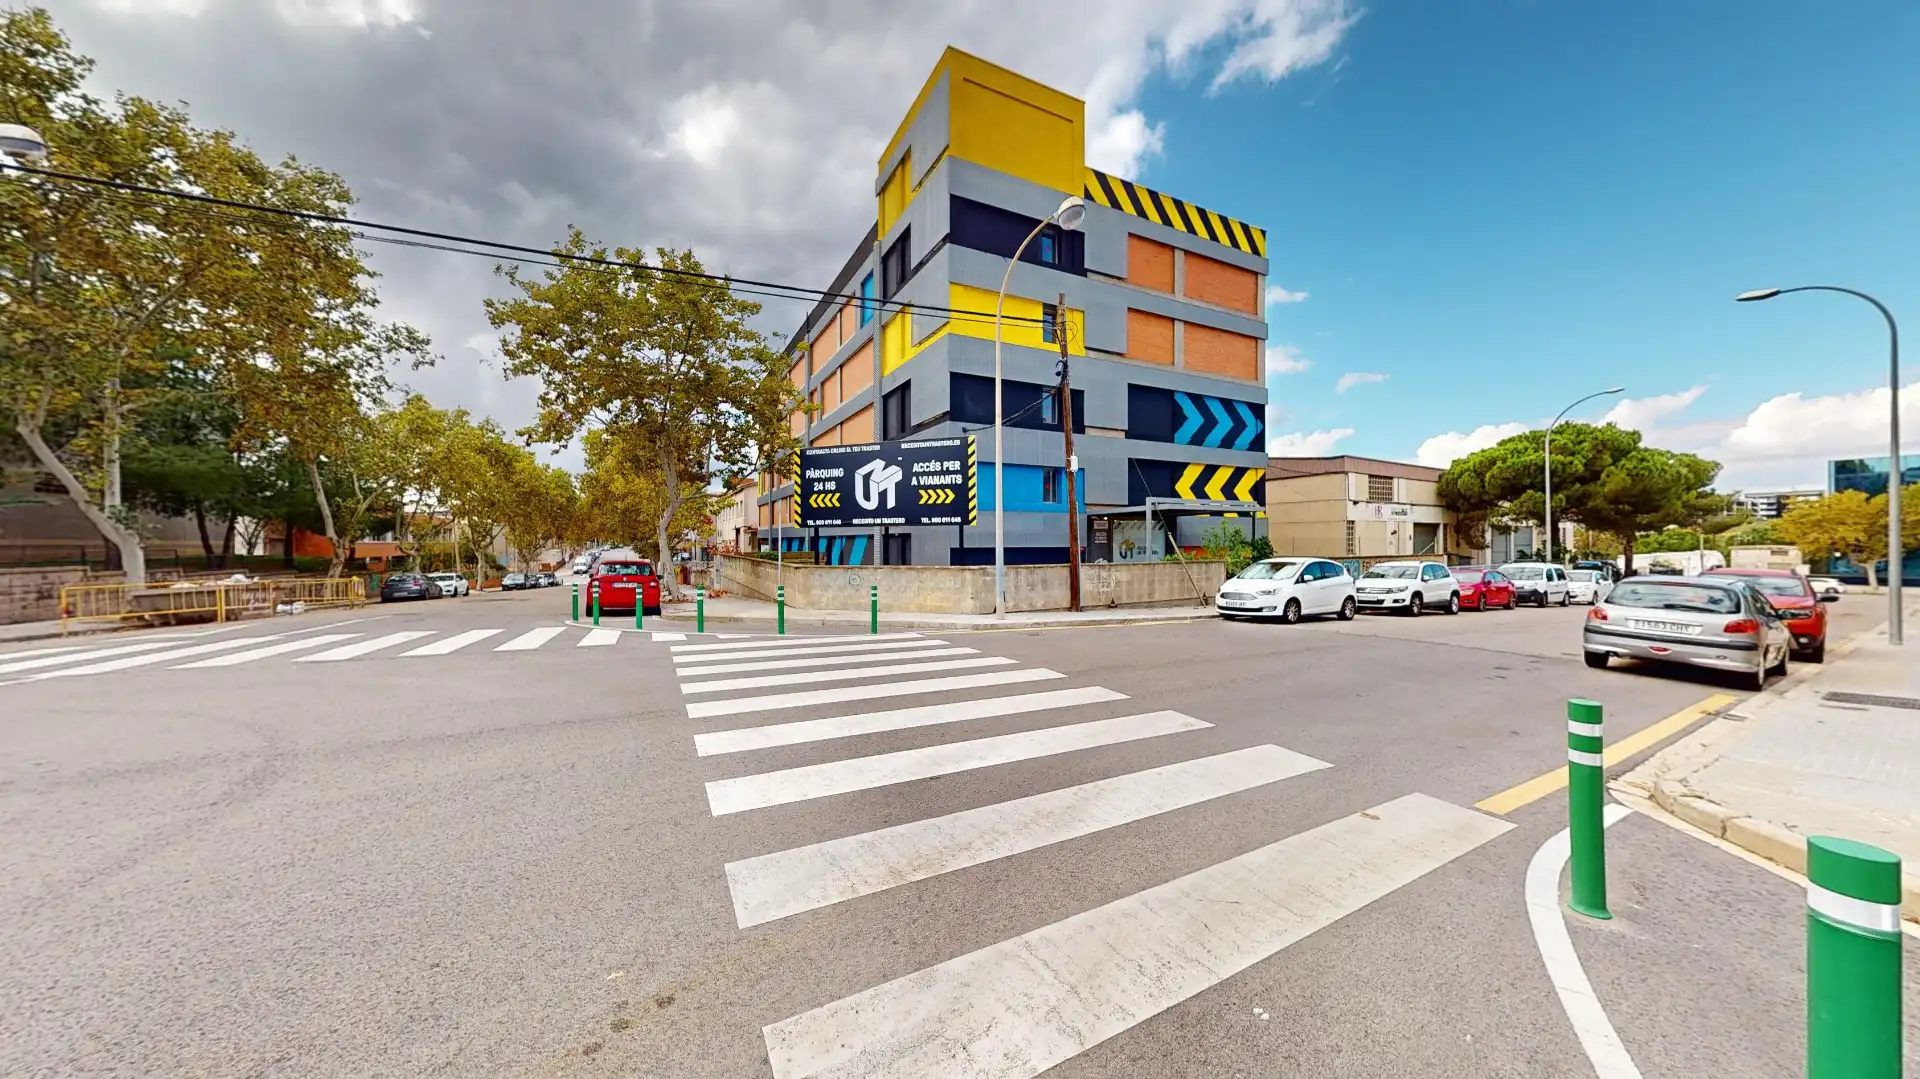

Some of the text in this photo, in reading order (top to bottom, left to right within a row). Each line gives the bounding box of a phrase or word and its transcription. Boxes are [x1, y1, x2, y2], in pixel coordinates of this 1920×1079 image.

[912, 460, 961, 473] ACCÉS PER
[805, 467, 844, 479] PÀRQUING
[813, 481, 836, 491] 24 HS
[910, 475, 963, 486] A VIANANTS
